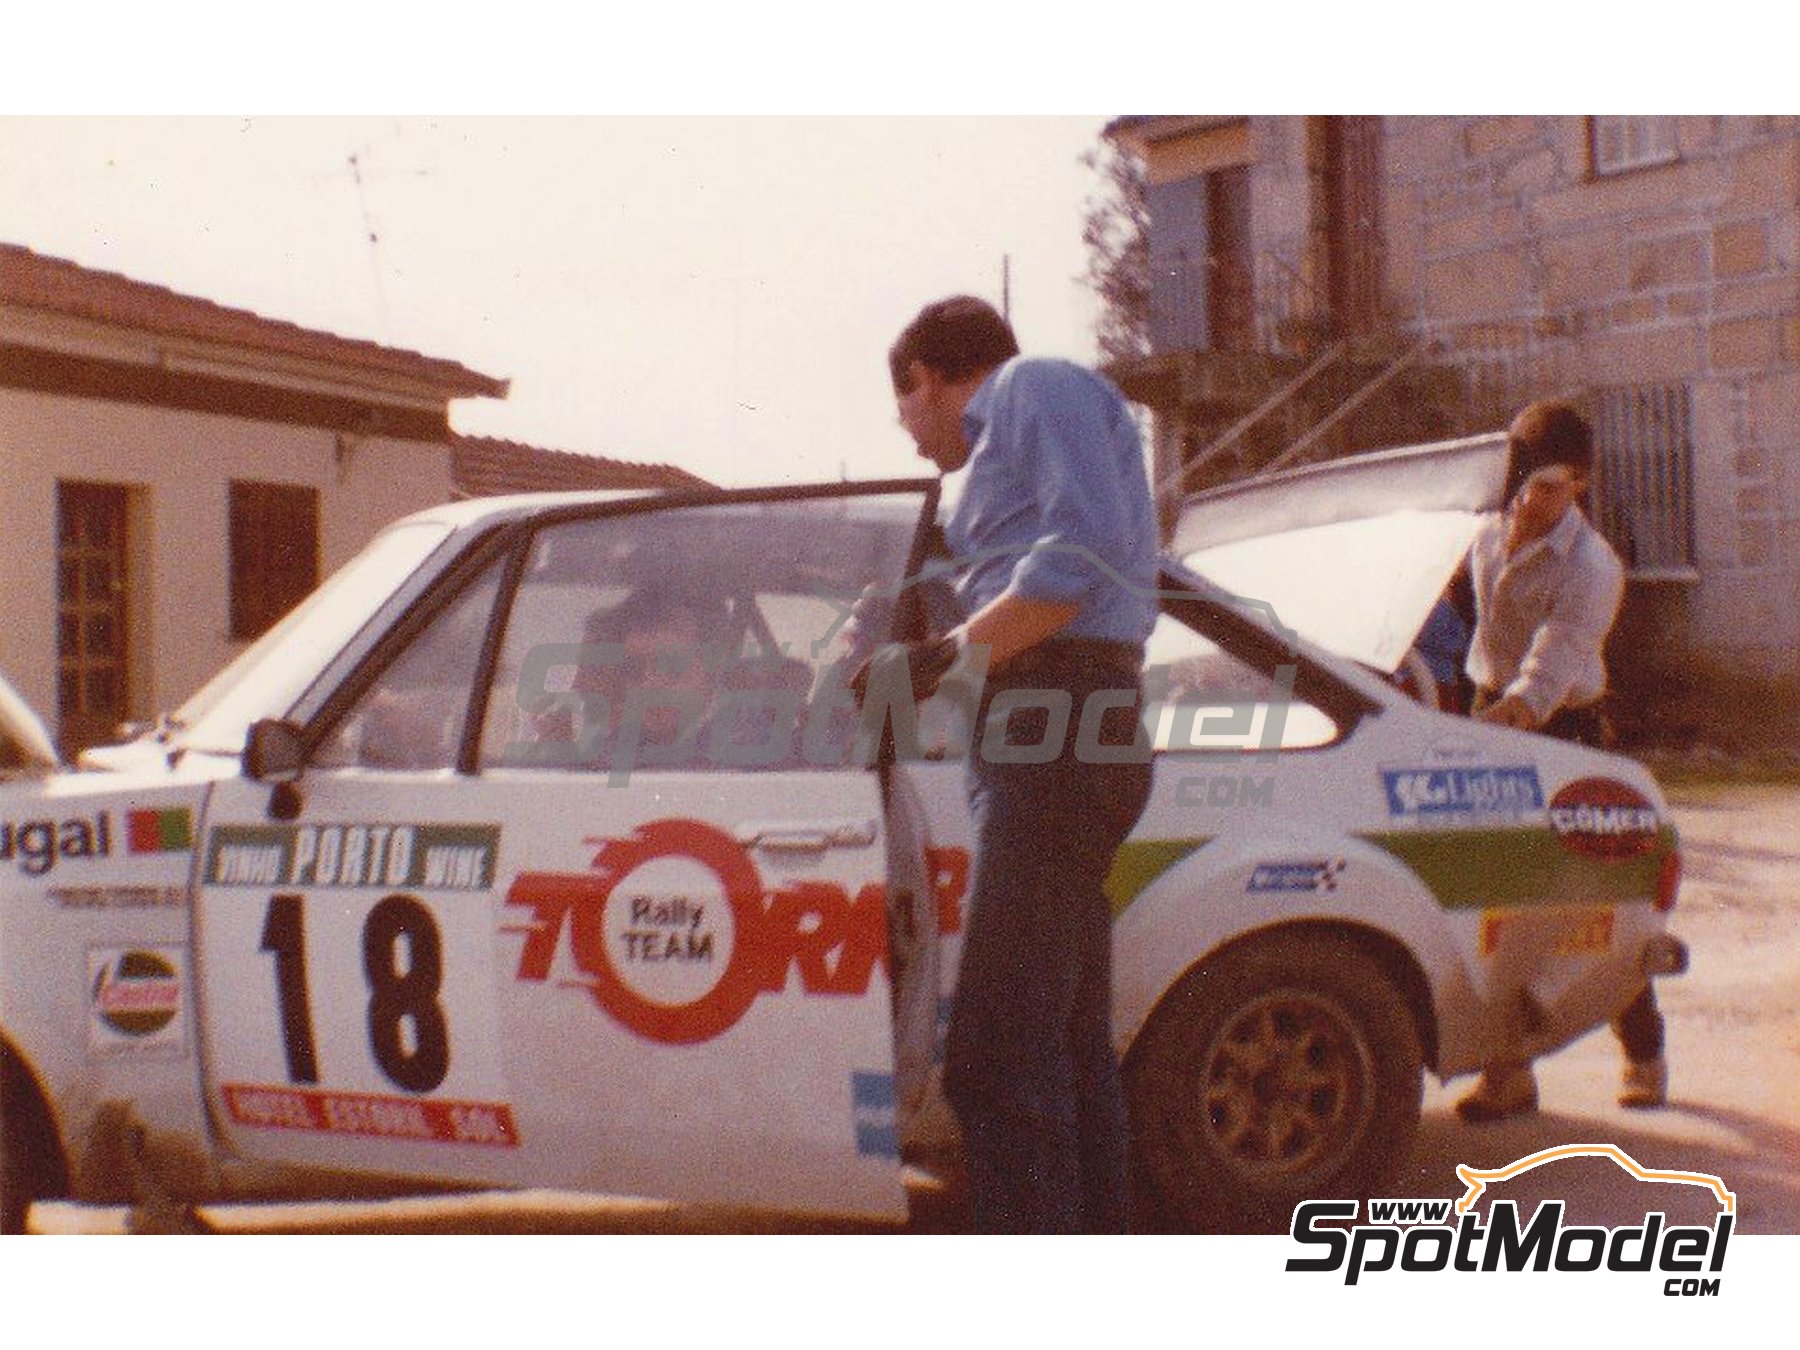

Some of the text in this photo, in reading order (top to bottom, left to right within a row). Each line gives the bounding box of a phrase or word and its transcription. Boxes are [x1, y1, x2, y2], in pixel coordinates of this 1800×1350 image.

[293, 826, 414, 887] PORTO
[630, 896, 704, 930] Rally
[622, 930, 714, 961] TEAM
[259, 894, 452, 1093] 18
